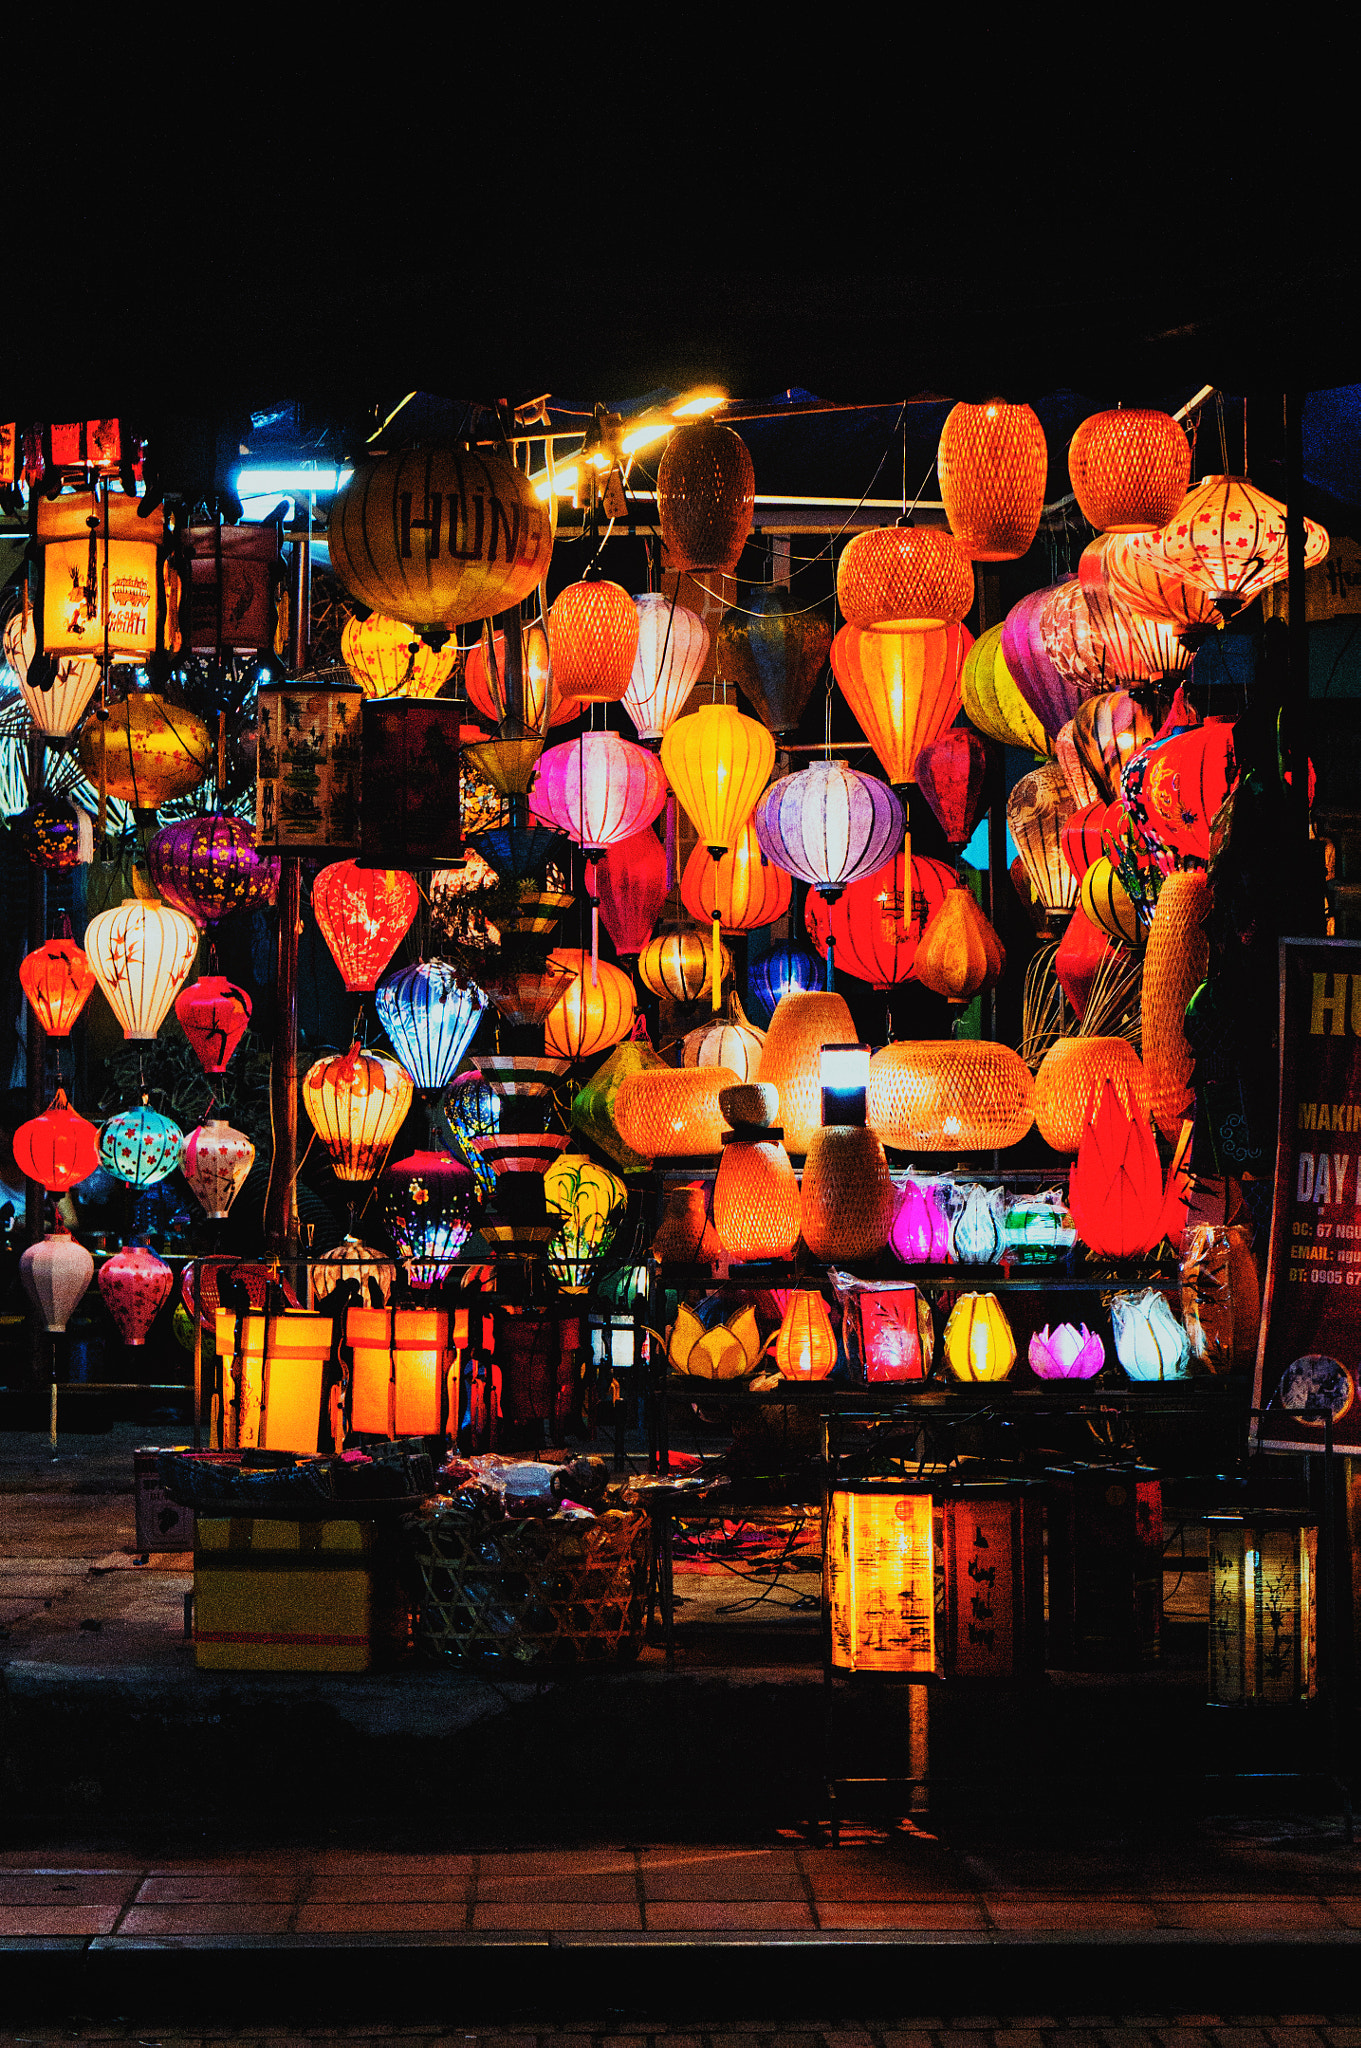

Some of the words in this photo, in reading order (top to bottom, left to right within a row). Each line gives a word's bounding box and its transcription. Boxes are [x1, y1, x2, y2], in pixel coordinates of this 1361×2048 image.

[1297, 1152, 1350, 1215] DẠY
[1316, 1223, 1333, 1238] 67
[1290, 1245, 1334, 1261] EMAIL:
[1310, 1268, 1343, 1285] 0905
